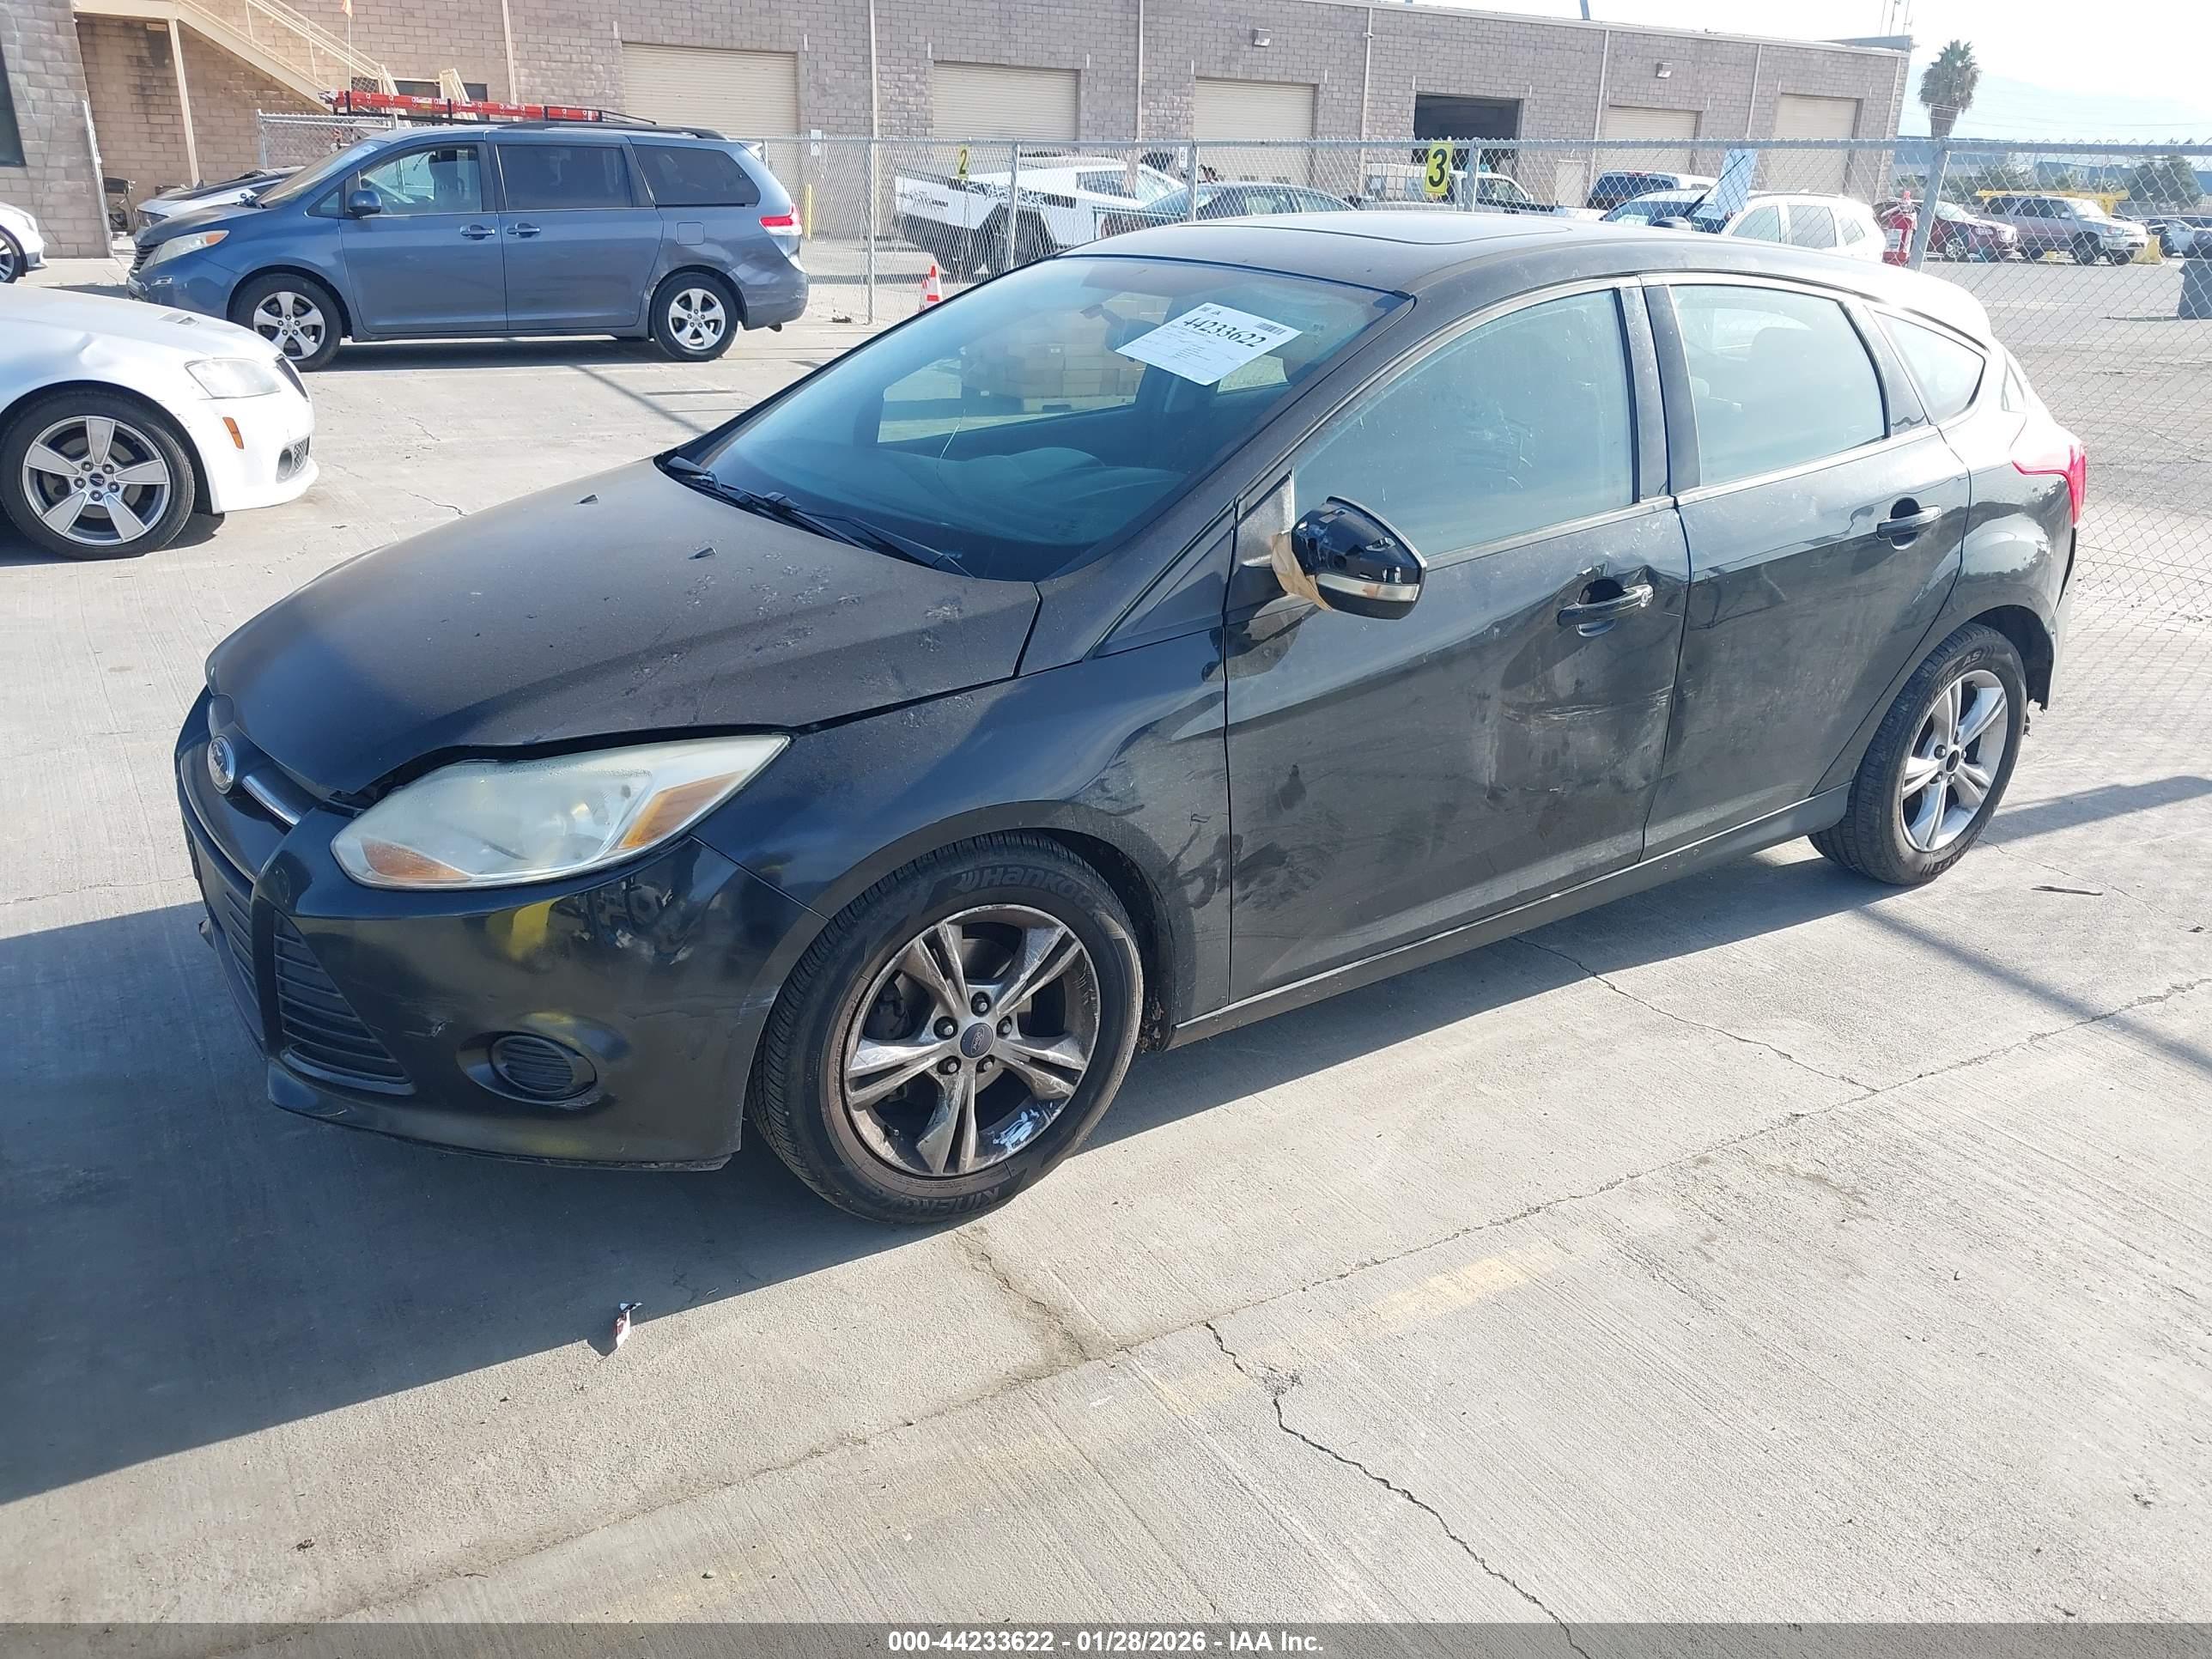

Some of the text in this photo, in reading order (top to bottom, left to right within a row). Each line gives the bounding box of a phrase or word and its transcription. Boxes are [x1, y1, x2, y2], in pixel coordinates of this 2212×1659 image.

[958, 149, 968, 174] 2
[1428, 148, 1448, 188] 3
[1183, 317, 1267, 348] 44233622
[1962, 650, 1982, 667] AS
